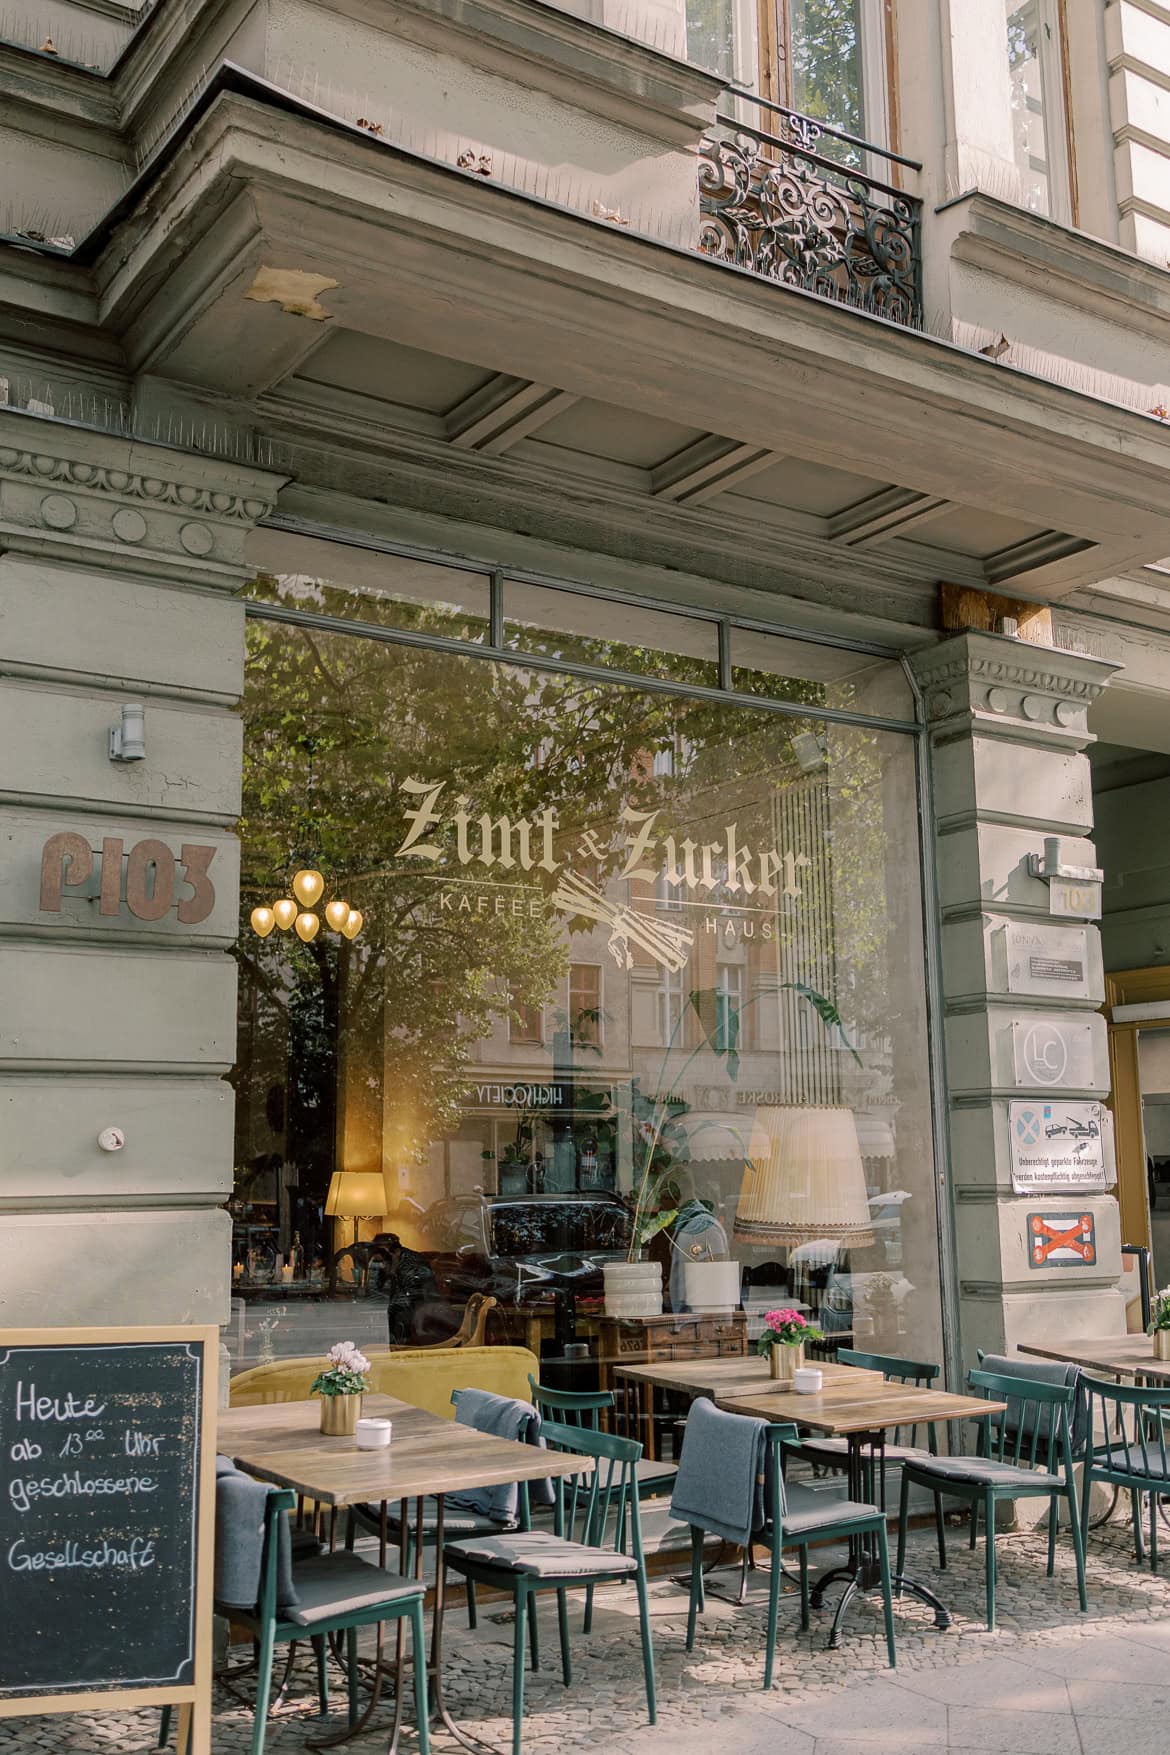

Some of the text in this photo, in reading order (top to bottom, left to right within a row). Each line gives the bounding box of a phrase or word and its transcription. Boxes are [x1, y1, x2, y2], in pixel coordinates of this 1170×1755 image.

[395, 776, 809, 898] Zimt & Zucker
[440, 892, 543, 918] KAFFEE
[705, 917, 772, 938] HAUS
[15, 1381, 106, 1421] Heute
[10, 1438, 42, 1461] ab
[124, 1429, 165, 1457] Uhr
[9, 1470, 158, 1512] geschlossene
[8, 1537, 155, 1571] Gesellschaft
